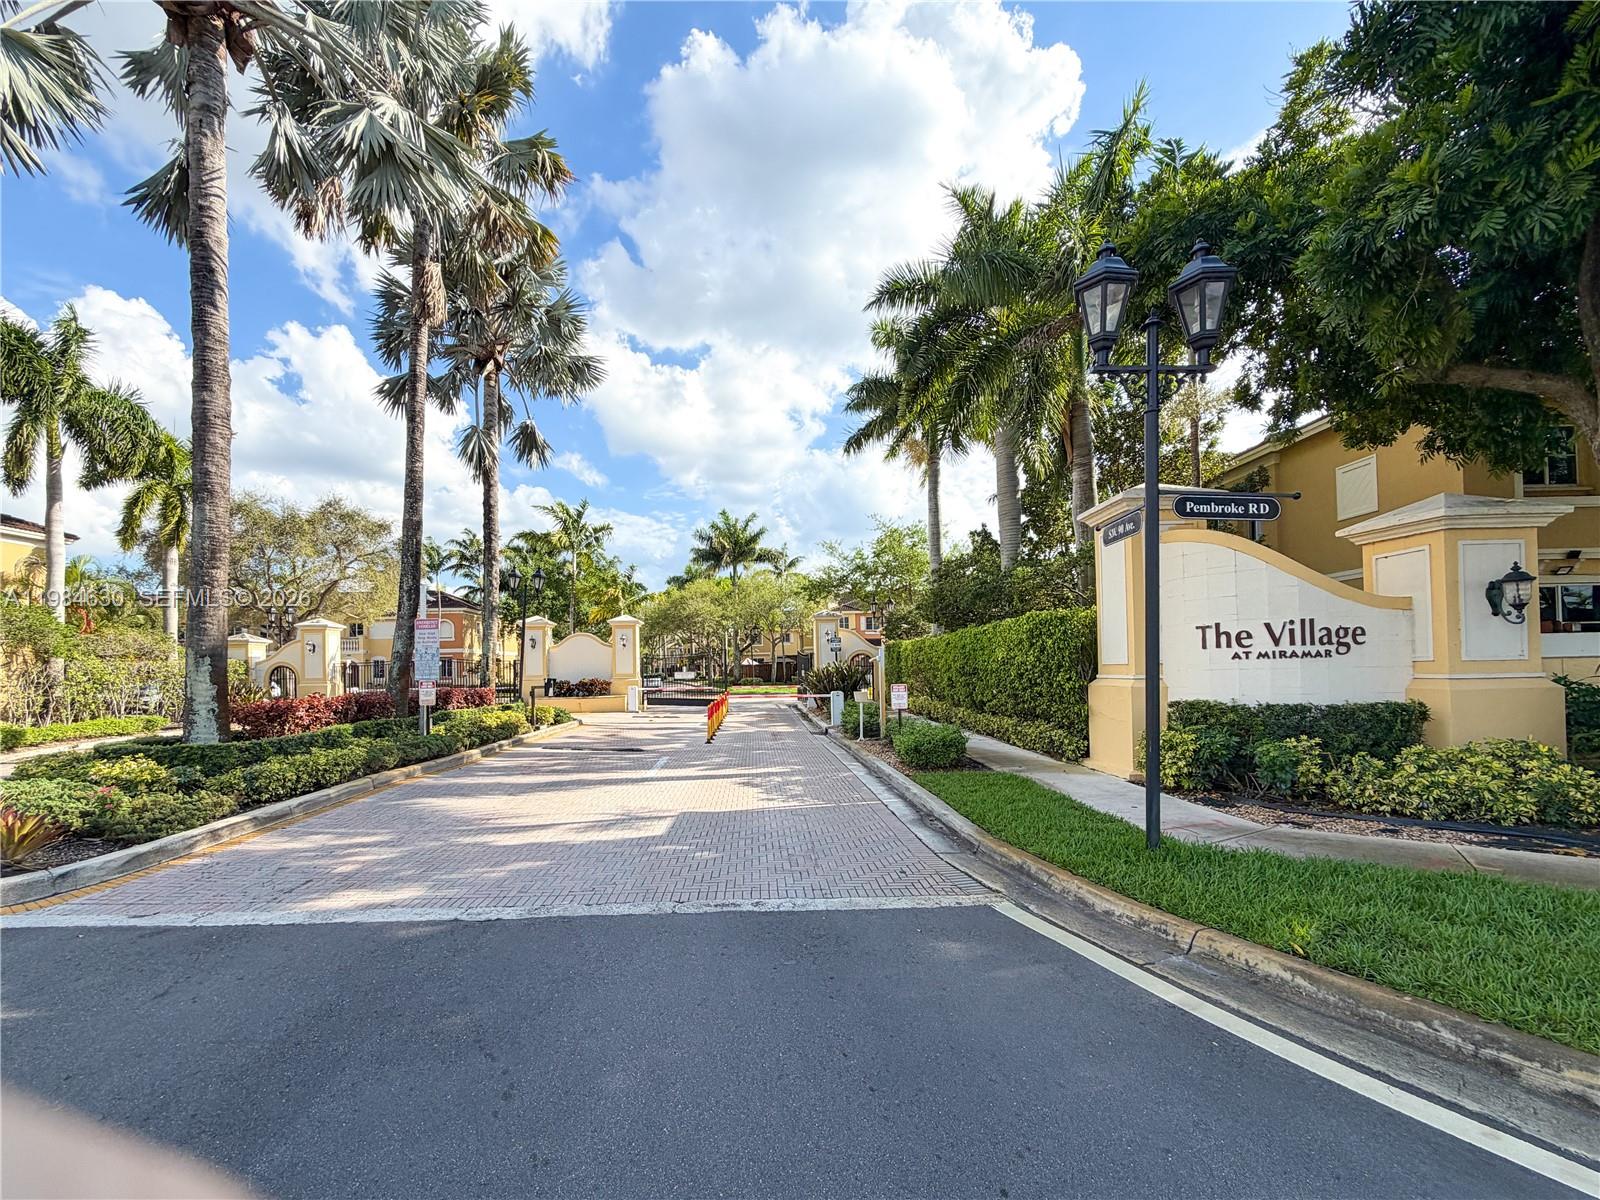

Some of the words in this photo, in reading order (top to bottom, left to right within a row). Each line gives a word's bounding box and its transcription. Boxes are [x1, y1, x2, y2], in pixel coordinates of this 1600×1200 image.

[1186, 501, 1245, 514] Pembroke
[1248, 502, 1269, 514] RD
[1195, 622, 1253, 650] The
[1263, 618, 1366, 655] Village
[1231, 651, 1252, 660] AT
[1256, 649, 1333, 660] MIRAMAR
